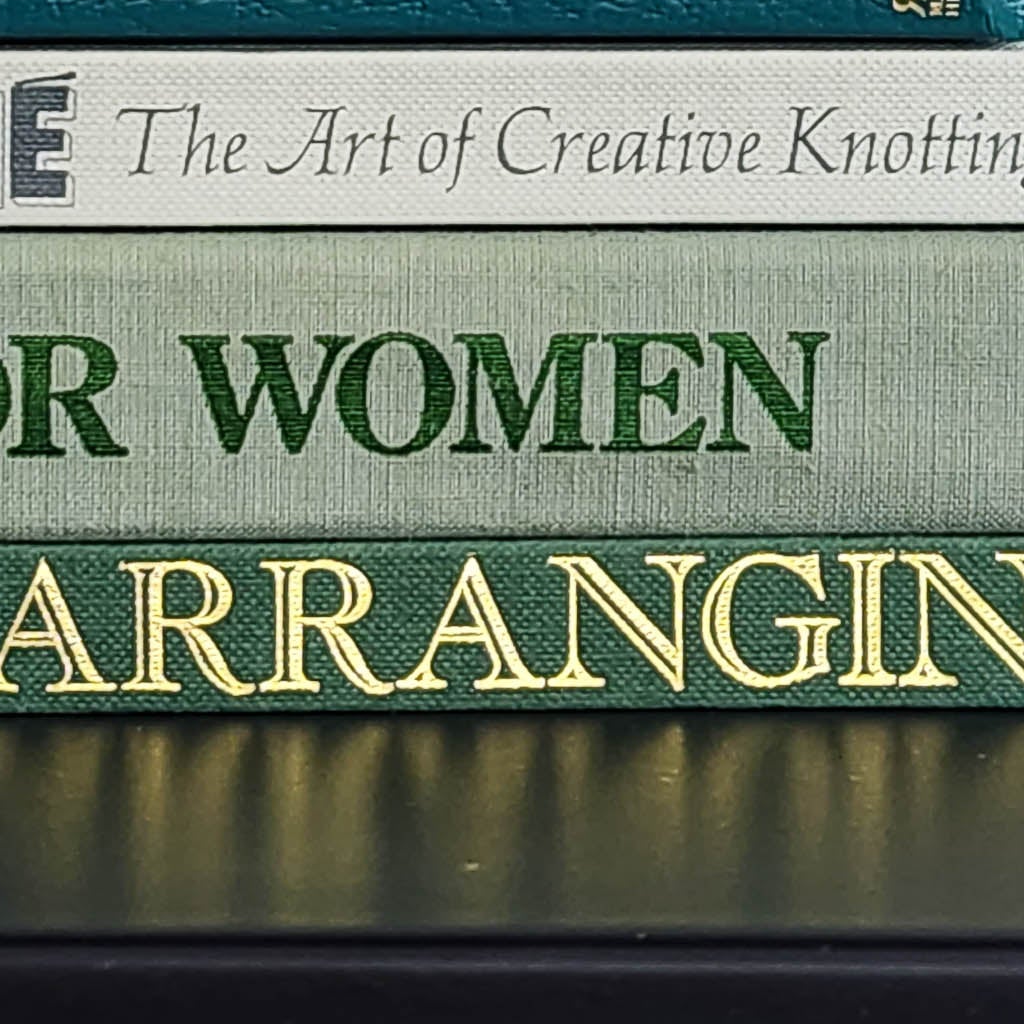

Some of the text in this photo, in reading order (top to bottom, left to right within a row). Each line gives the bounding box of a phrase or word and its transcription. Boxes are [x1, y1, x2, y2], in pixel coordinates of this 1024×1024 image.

[116, 102, 1024, 194] The Art of Creative Knottin
[179, 331, 831, 456] WOMEN
